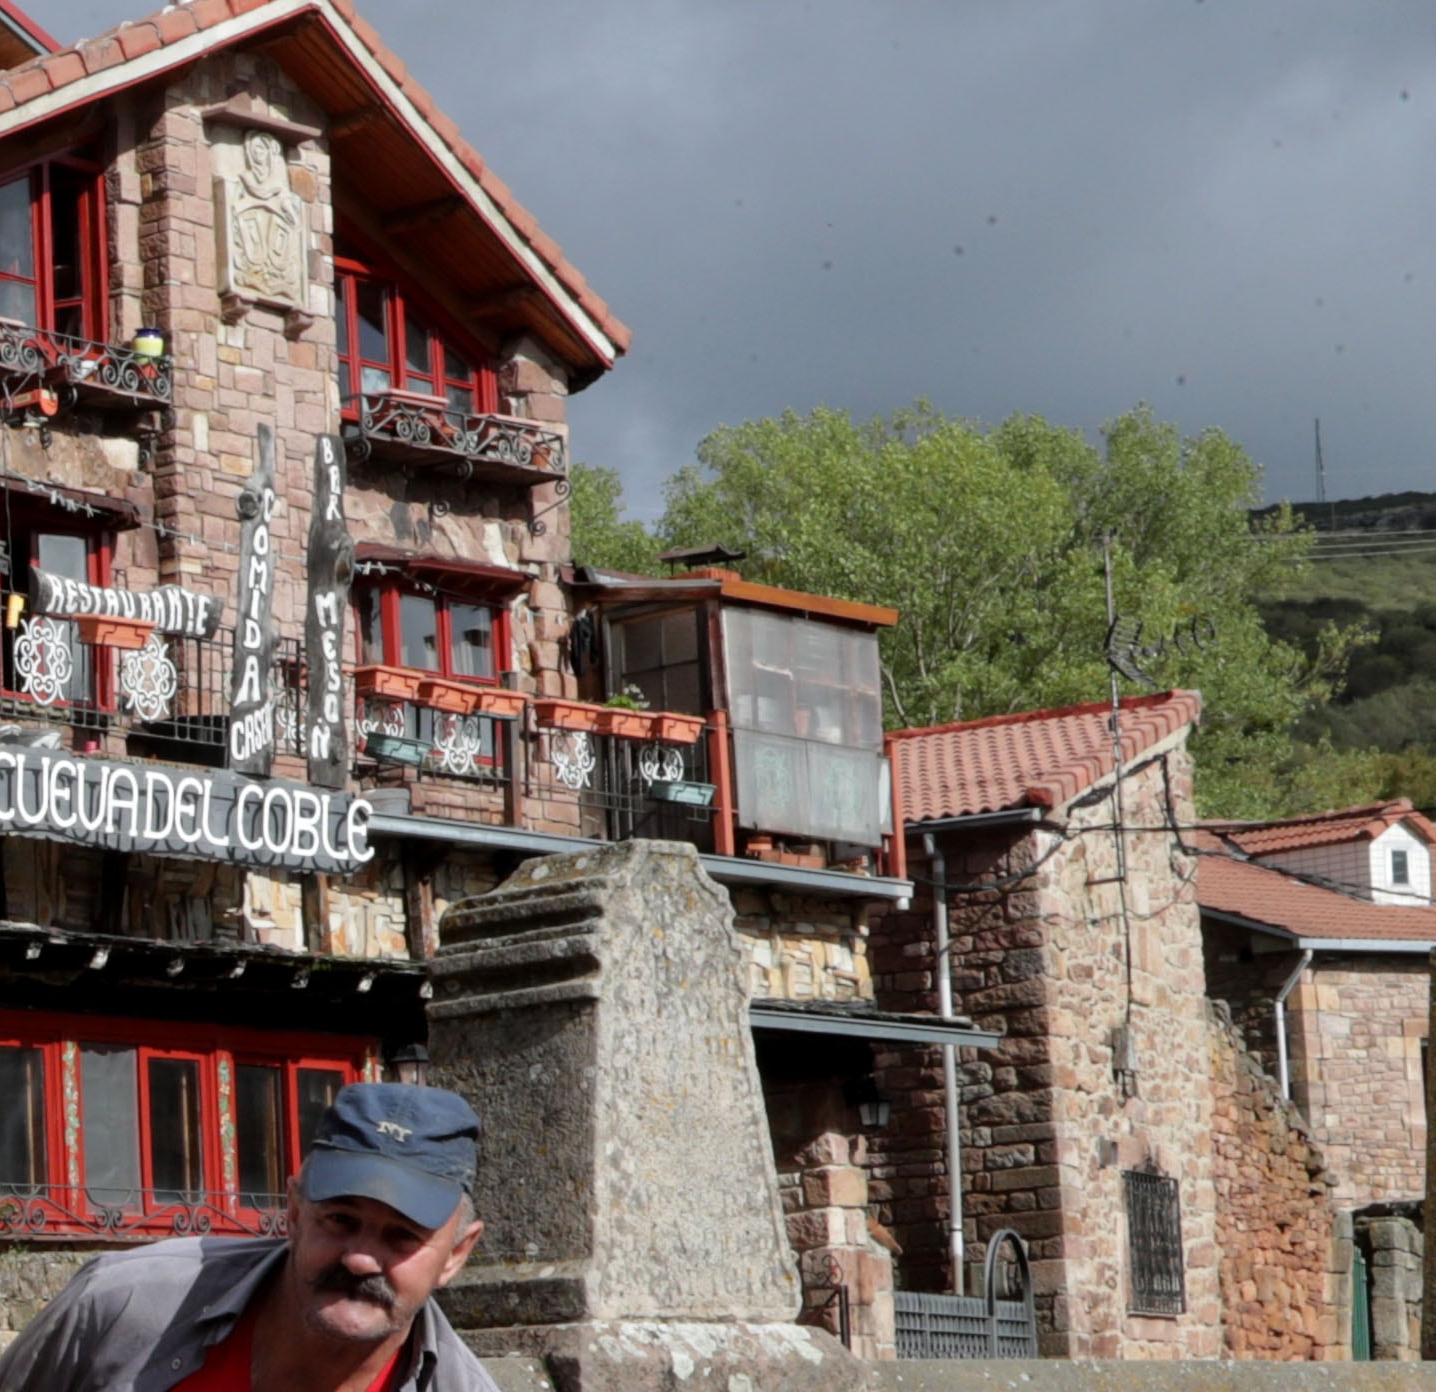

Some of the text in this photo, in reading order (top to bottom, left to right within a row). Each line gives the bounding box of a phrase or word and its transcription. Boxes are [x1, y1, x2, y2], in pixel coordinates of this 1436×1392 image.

[45, 573, 211, 636] RESTAURANTE
[234, 487, 275, 706] COMIDA
[236, 783, 376, 863] COBLE
